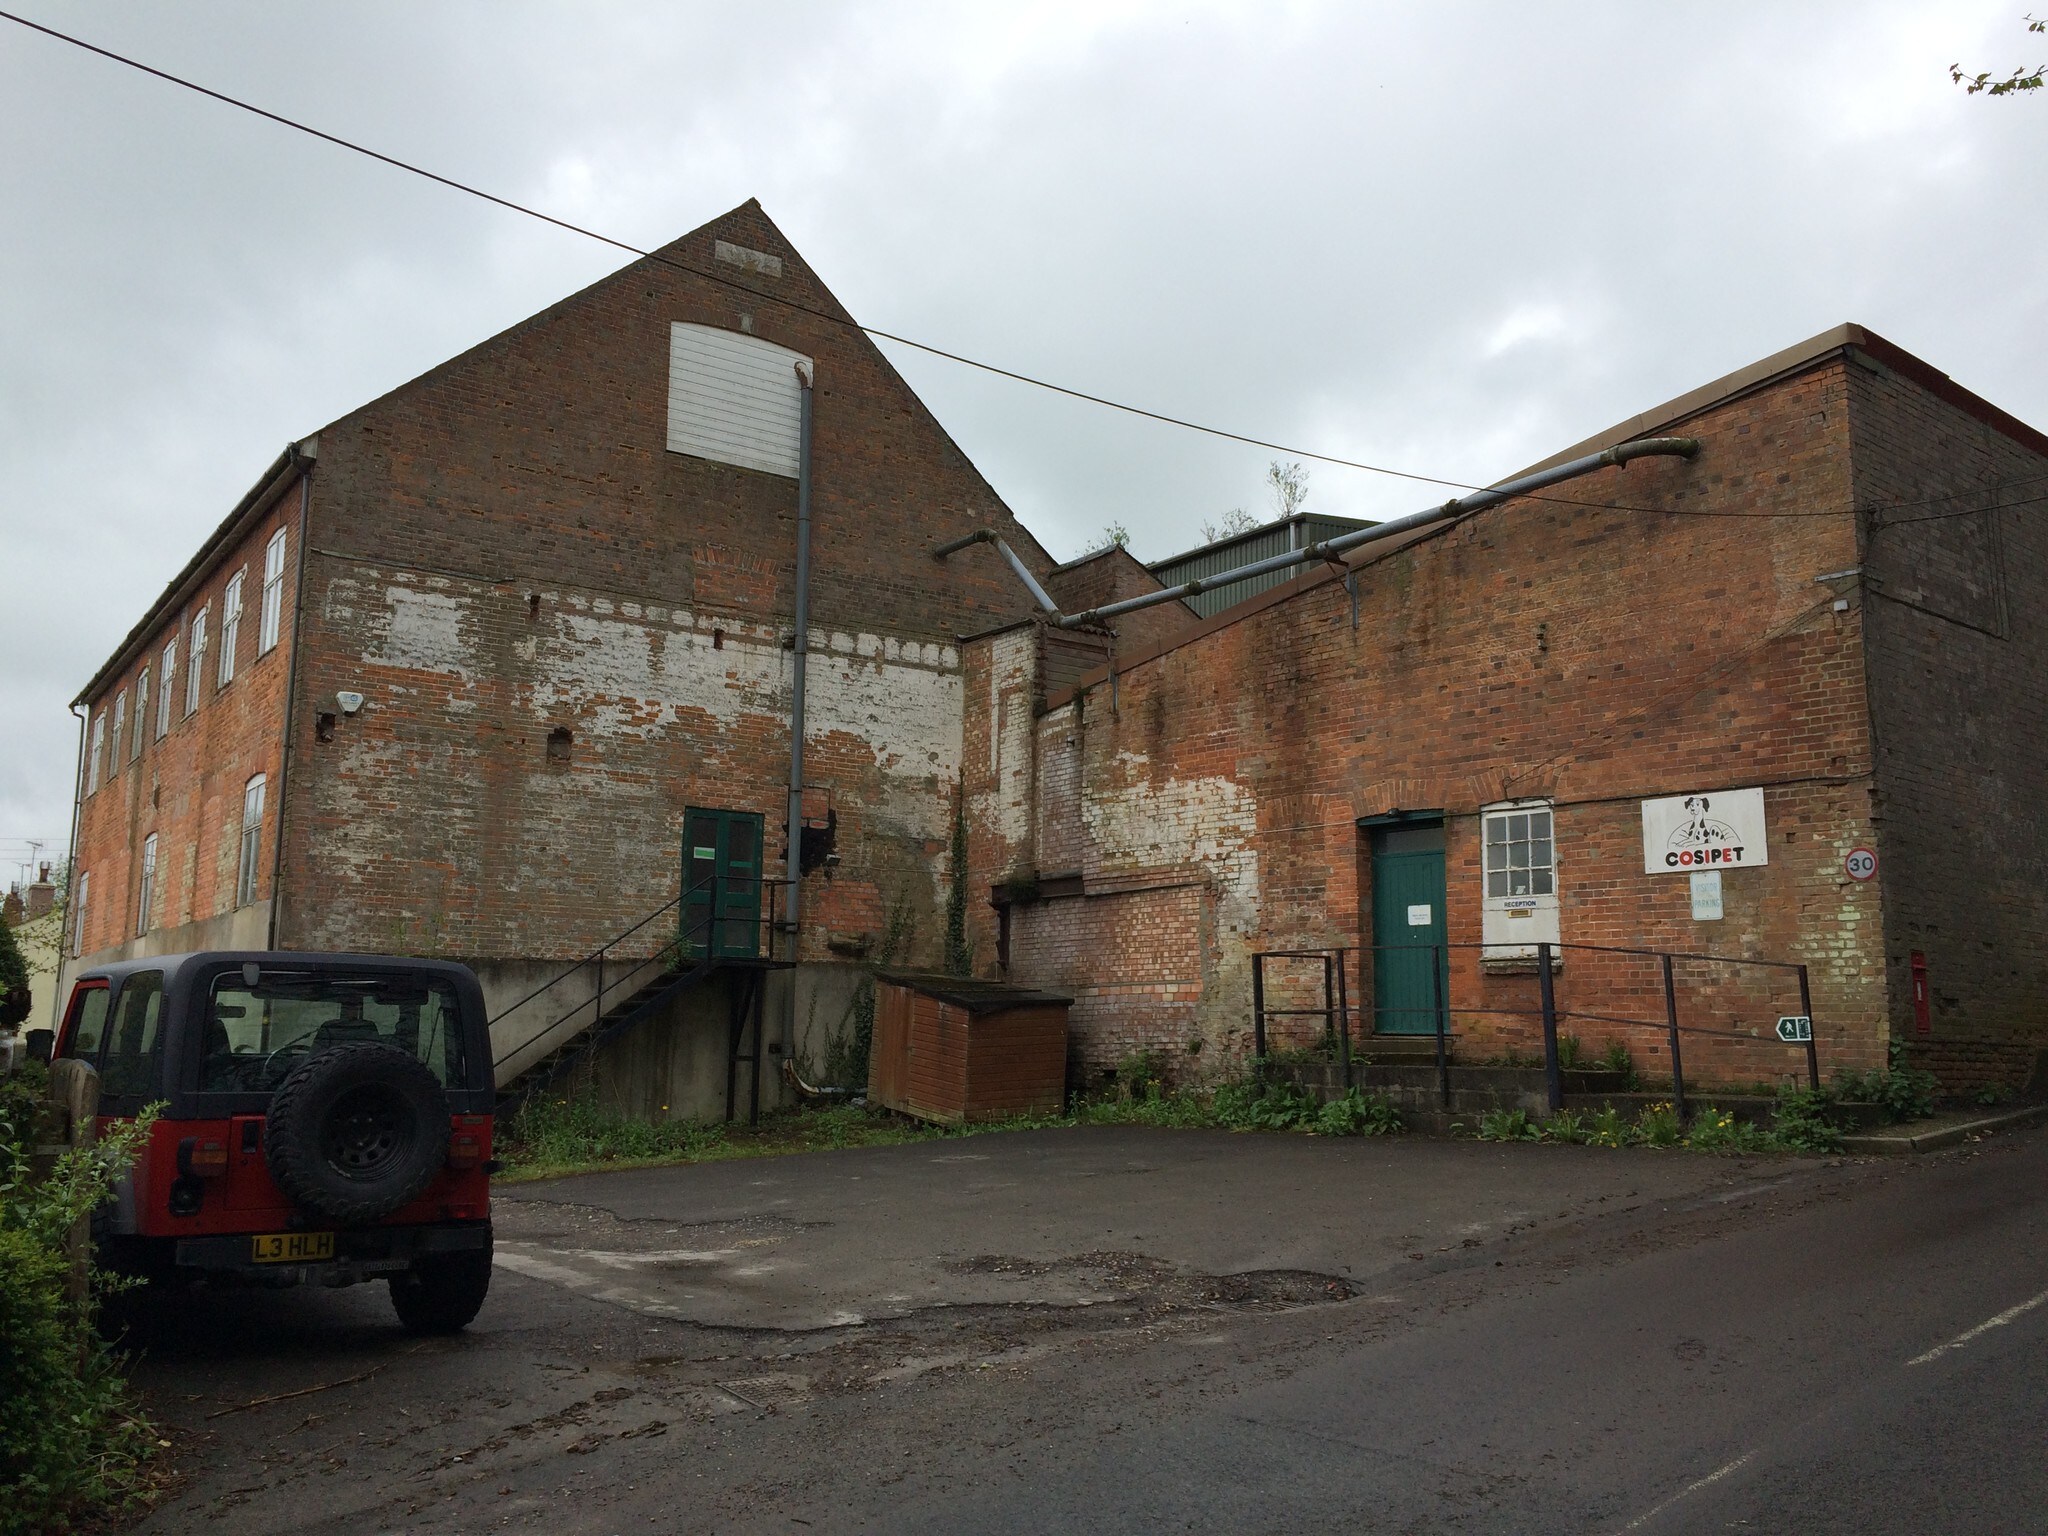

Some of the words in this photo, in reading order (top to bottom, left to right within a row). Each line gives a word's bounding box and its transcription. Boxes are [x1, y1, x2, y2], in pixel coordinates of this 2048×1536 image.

[1665, 847, 1744, 867] COSIPET
[1849, 857, 1874, 872] 30
[1504, 900, 1536, 908] RECEPTION
[1694, 898, 1720, 908] PARKING
[254, 1237, 282, 1258] L3
[289, 1234, 331, 1256] HLH
